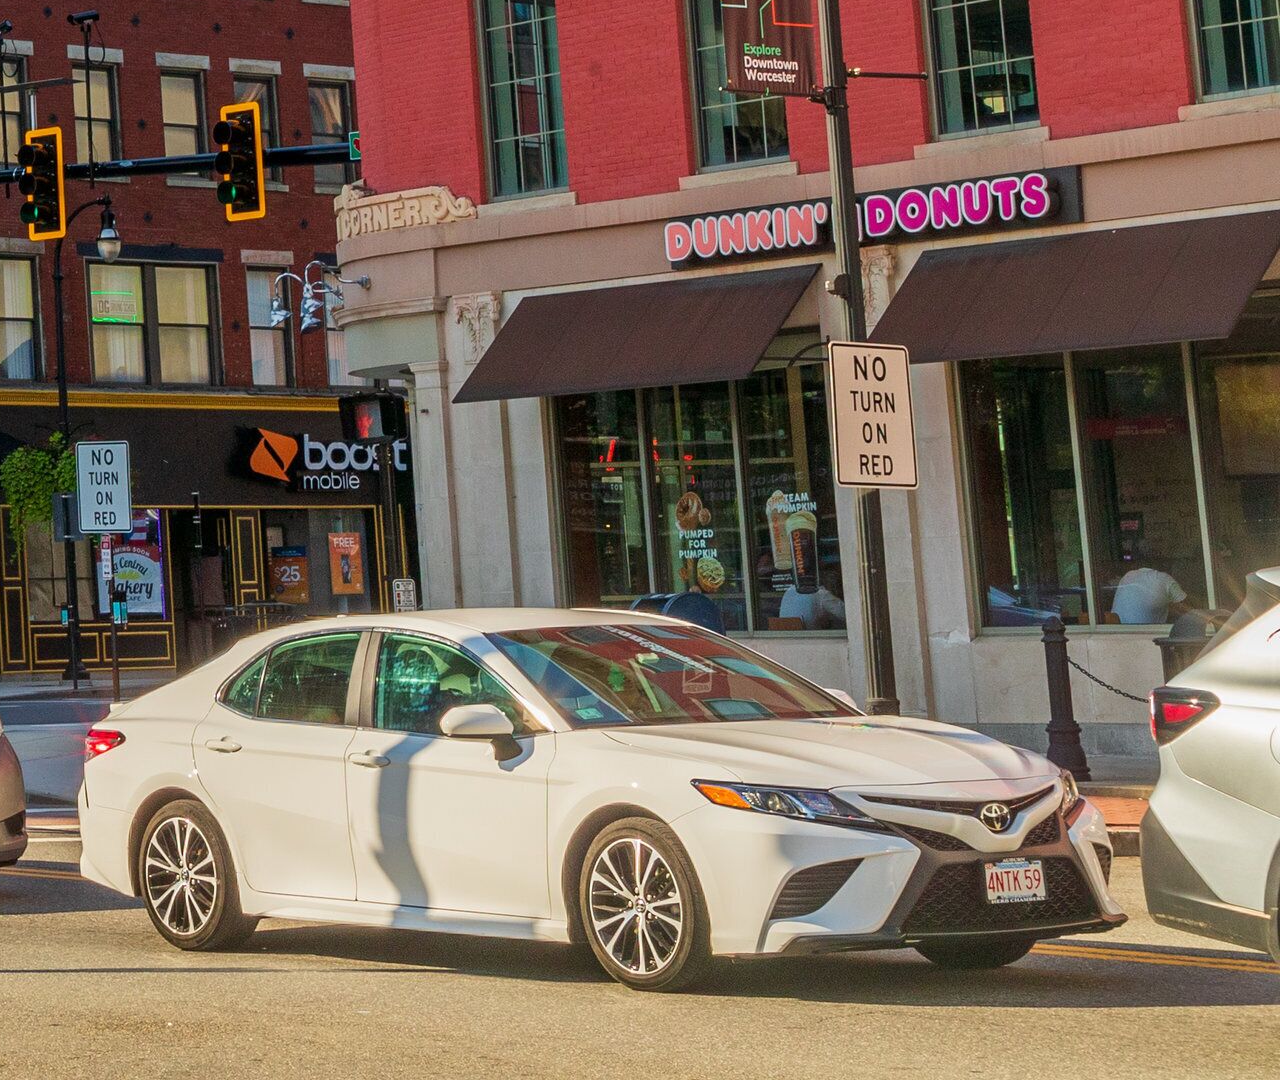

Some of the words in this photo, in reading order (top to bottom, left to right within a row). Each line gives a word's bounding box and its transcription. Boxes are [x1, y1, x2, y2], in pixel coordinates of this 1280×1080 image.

[743, 42, 782, 57] Explore
[743, 56, 799, 71] Downtown
[744, 68, 797, 83] Worcester
[664, 202, 828, 262] DUNKIN'
[864, 173, 1051, 238] DONUTS
[853, 355, 887, 382] NO
[850, 390, 896, 414] TURN
[862, 422, 888, 445] ON
[91, 449, 114, 466] NO
[303, 433, 408, 471] boot
[859, 454, 894, 477] RED
[88, 471, 119, 486] TURN
[303, 471, 360, 490] mobile
[96, 491, 113, 505] ON
[783, 491, 810, 503] TEAM
[776, 501, 817, 514] PUMPKIN
[94, 511, 117, 526] RED
[333, 536, 356, 548] FREE
[679, 529, 714, 540] PUMPED
[688, 539, 707, 549] FOR
[679, 548, 718, 559] PUMPKIN
[119, 556, 149, 576] Central
[273, 565, 301, 583] $25
[106, 580, 154, 600] akery
[988, 869, 1022, 893] 4NTK
[1024, 868, 1041, 890] 59
